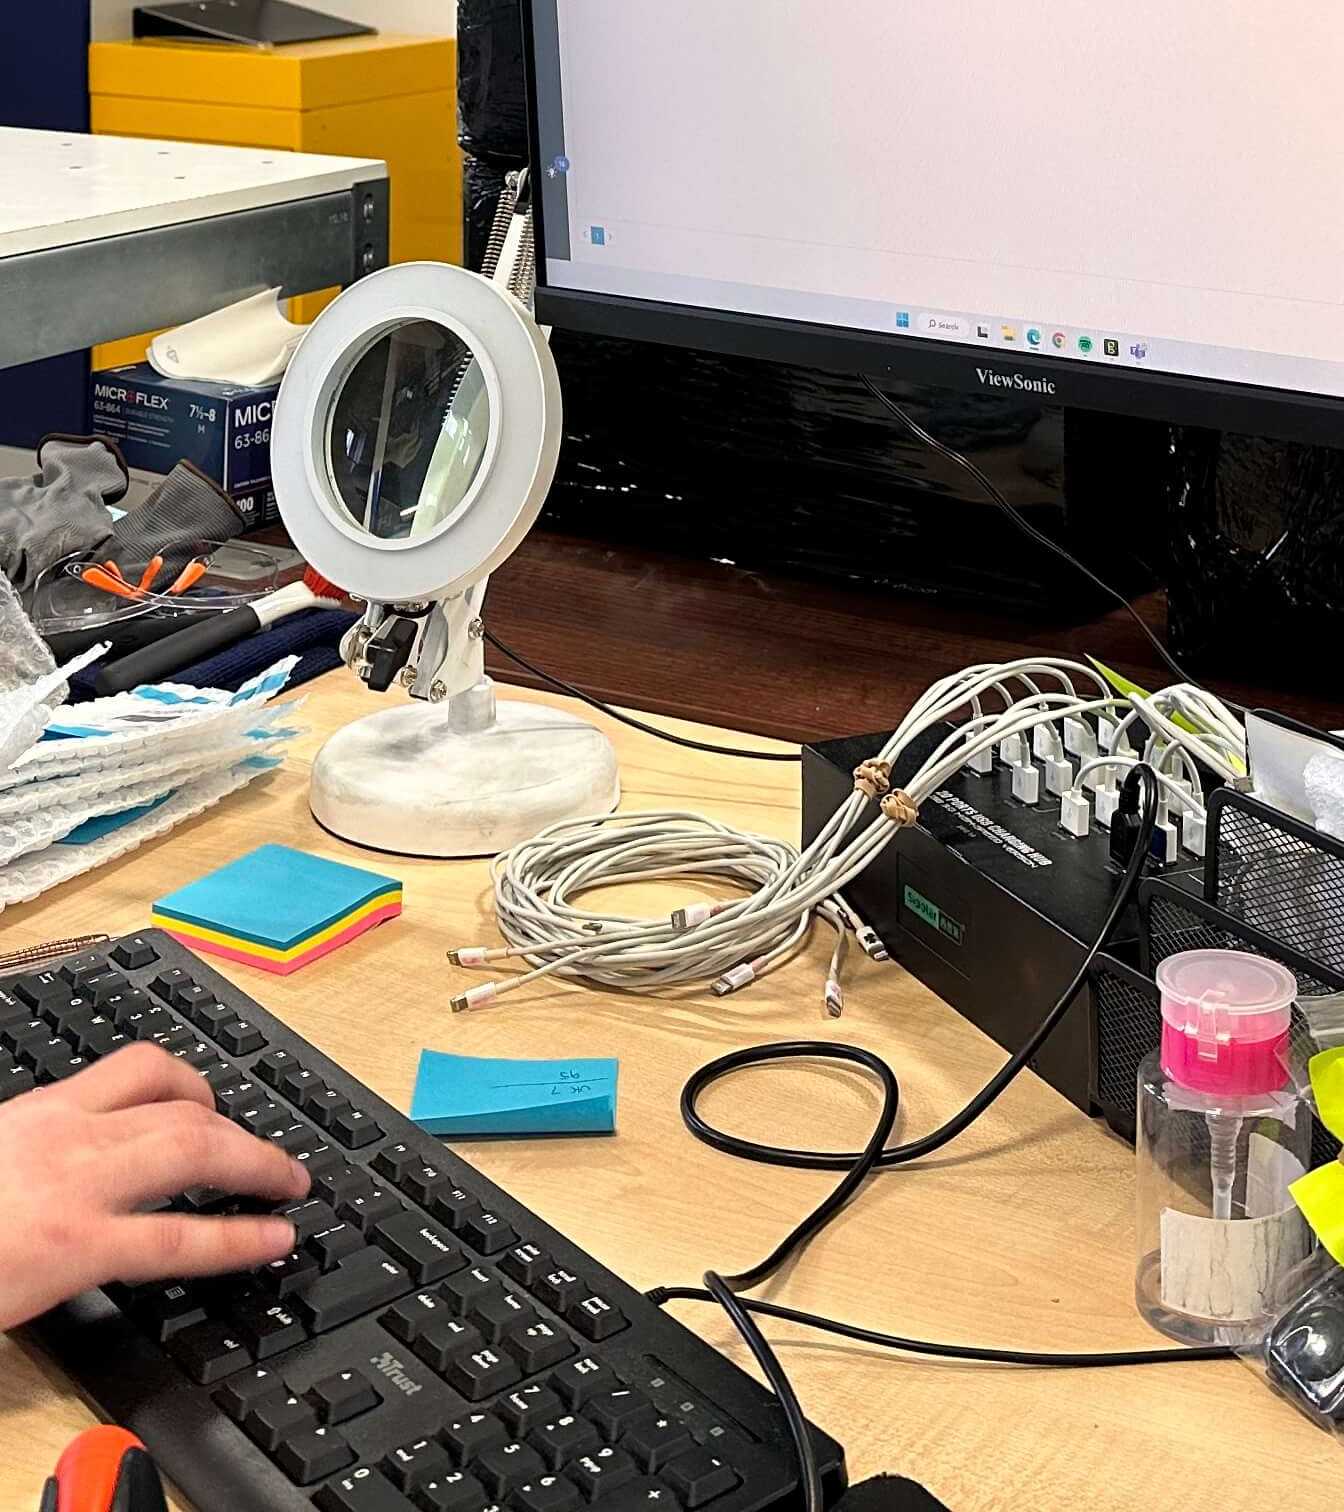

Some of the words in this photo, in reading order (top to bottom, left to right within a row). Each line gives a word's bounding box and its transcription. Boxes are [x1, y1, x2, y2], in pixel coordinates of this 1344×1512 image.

[975, 368, 1057, 395] ViewSonic
[94, 384, 169, 410] MICROFLEX
[234, 428, 272, 450] 63-86
[946, 797, 979, 816] PORTS
[972, 813, 995, 826] USB
[987, 825, 1036, 854] CHARGING
[1026, 852, 1054, 867] HUB
[419, 1228, 449, 1252] backspace
[381, 1358, 423, 1396] Trust
